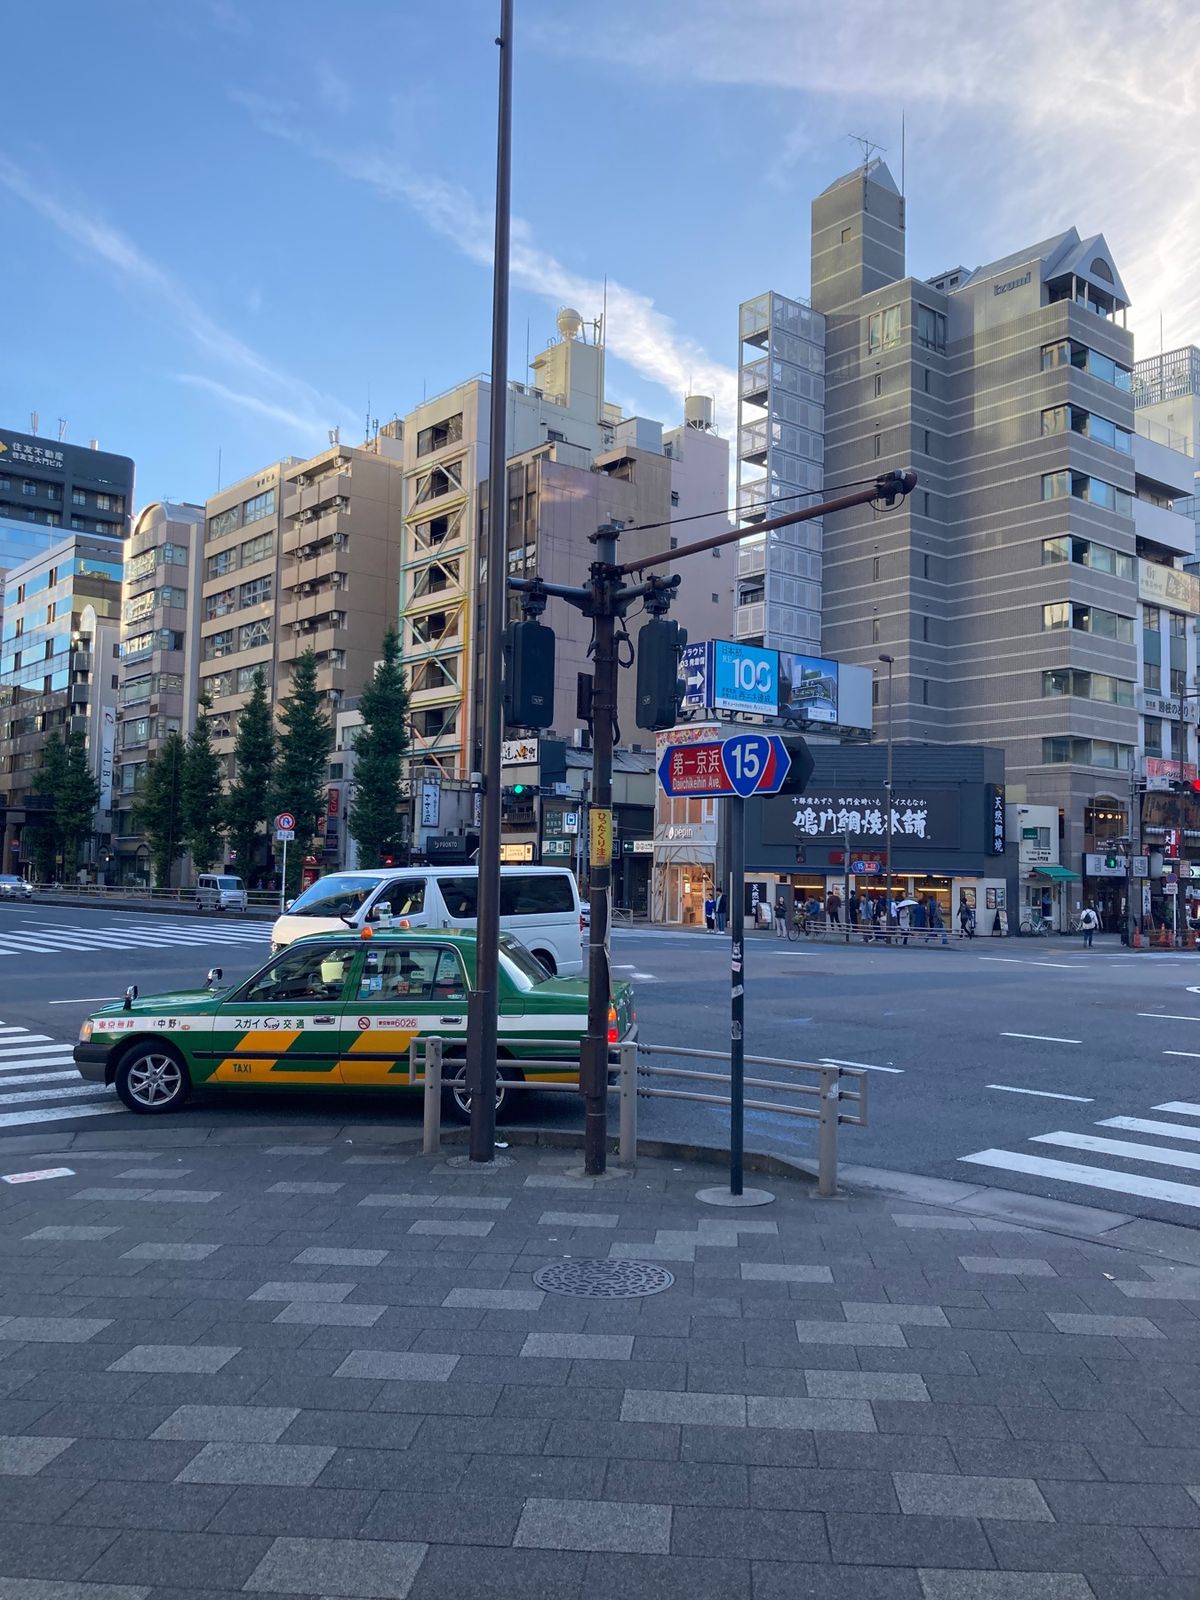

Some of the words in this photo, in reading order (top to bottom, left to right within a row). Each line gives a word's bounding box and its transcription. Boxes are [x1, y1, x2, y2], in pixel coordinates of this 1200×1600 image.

[12, 442, 63, 461] 住友不動産
[102, 747, 111, 788] ALBA
[673, 749, 720, 776] 第一京浜
[731, 742, 760, 779] 15
[890, 798, 928, 807] イスもなか
[792, 806, 928, 839] 鳴門鯛焼本舗
[234, 1019, 260, 1029] スガイ
[232, 1063, 252, 1073] TAXI
